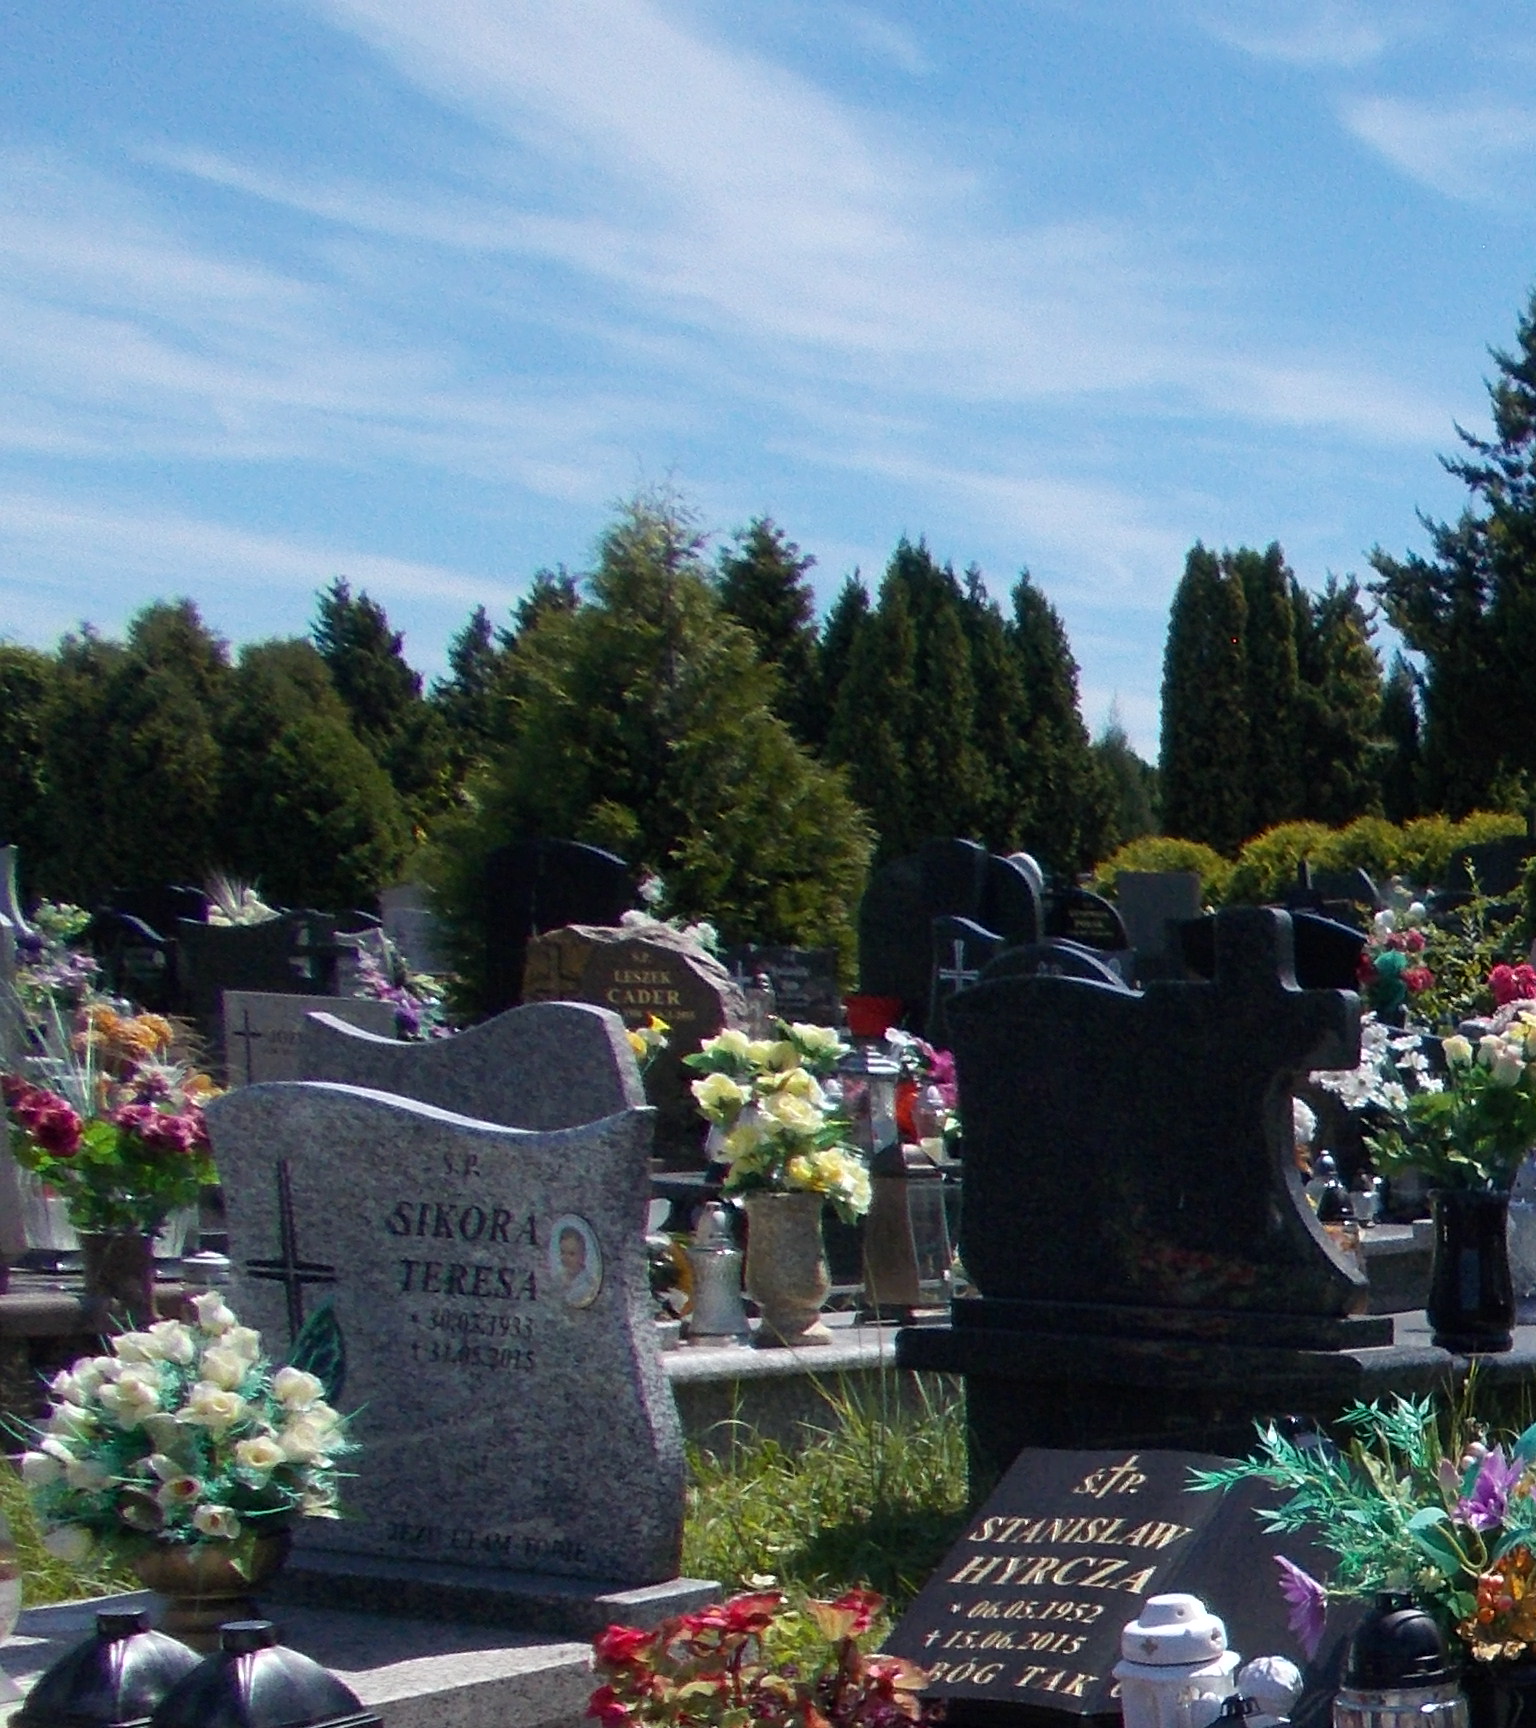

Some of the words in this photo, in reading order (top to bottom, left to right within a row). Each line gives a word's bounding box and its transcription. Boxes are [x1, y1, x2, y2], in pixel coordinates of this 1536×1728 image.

[613, 969, 672, 985] LESZEK
[606, 987, 681, 1006] CADER
[384, 1199, 542, 1247] SIKORA
[398, 1257, 538, 1302] TERESA
[947, 1555, 1158, 1594] HYRCZA
[967, 1600, 1106, 1624] 06.05.1952
[941, 1629, 1088, 1655] 15.06.2015
[926, 1656, 1006, 1685] BÓG
[1014, 1664, 1100, 1698] TAK
